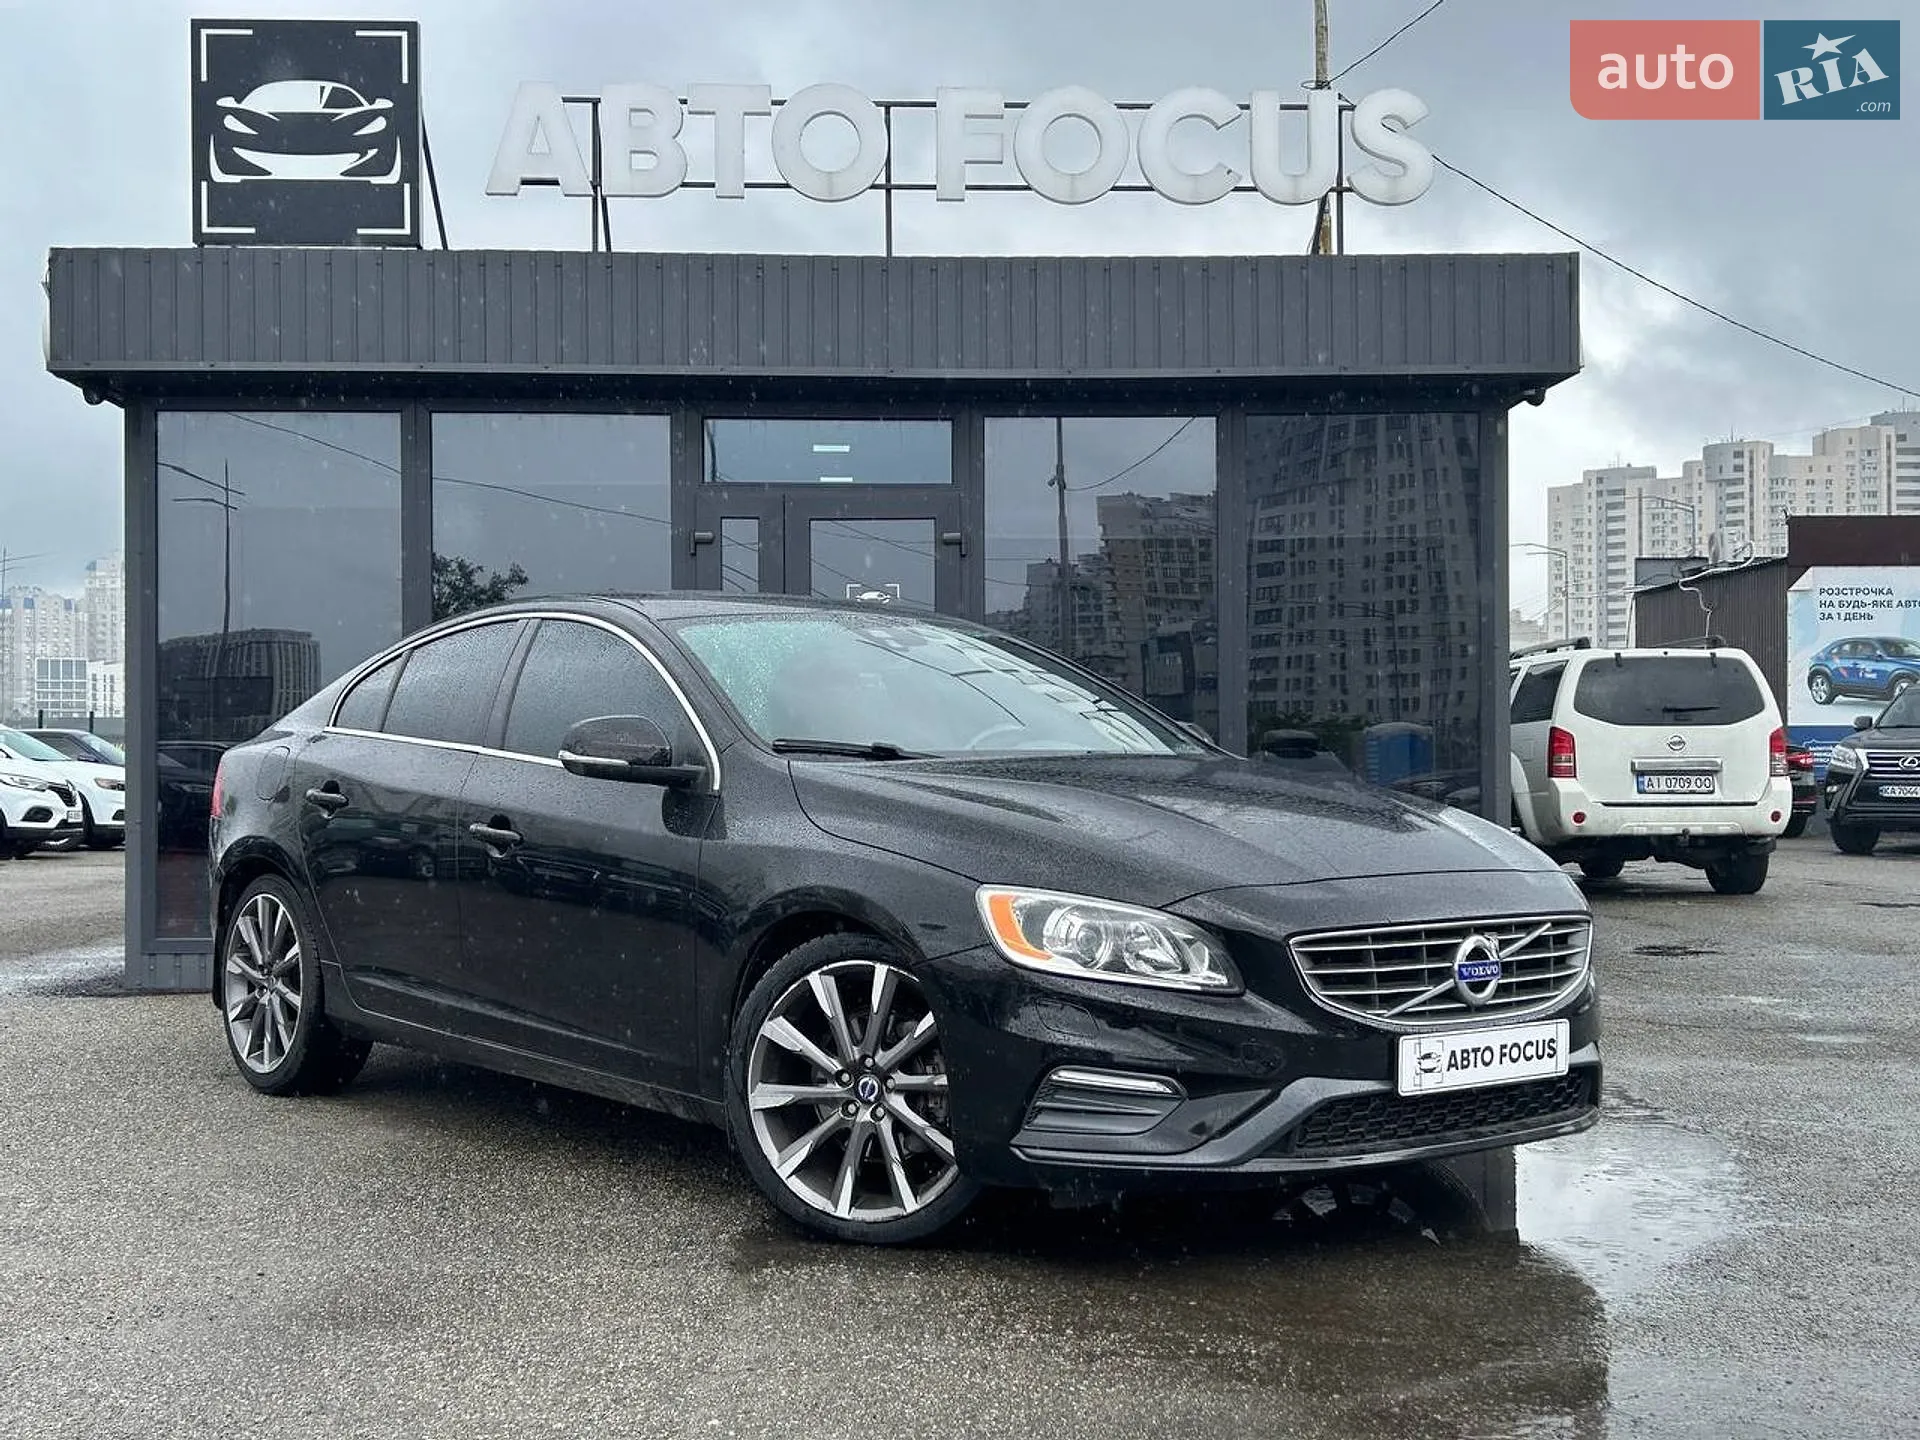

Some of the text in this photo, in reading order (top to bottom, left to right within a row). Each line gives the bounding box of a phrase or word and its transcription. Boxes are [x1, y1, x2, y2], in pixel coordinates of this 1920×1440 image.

[936, 85, 1435, 206] FOCUS
[1819, 587, 1894, 596] РОЗСТРОЧКА
[1819, 600, 1920, 609] НА БУДЬ-ЯКЕ АВТ
[1819, 612, 1874, 622] ЗА 1 ДЕНЬ
[1665, 777, 1692, 789] 0709
[1462, 964, 1499, 977] VOLVO
[1500, 1038, 1557, 1065] FOCUS
